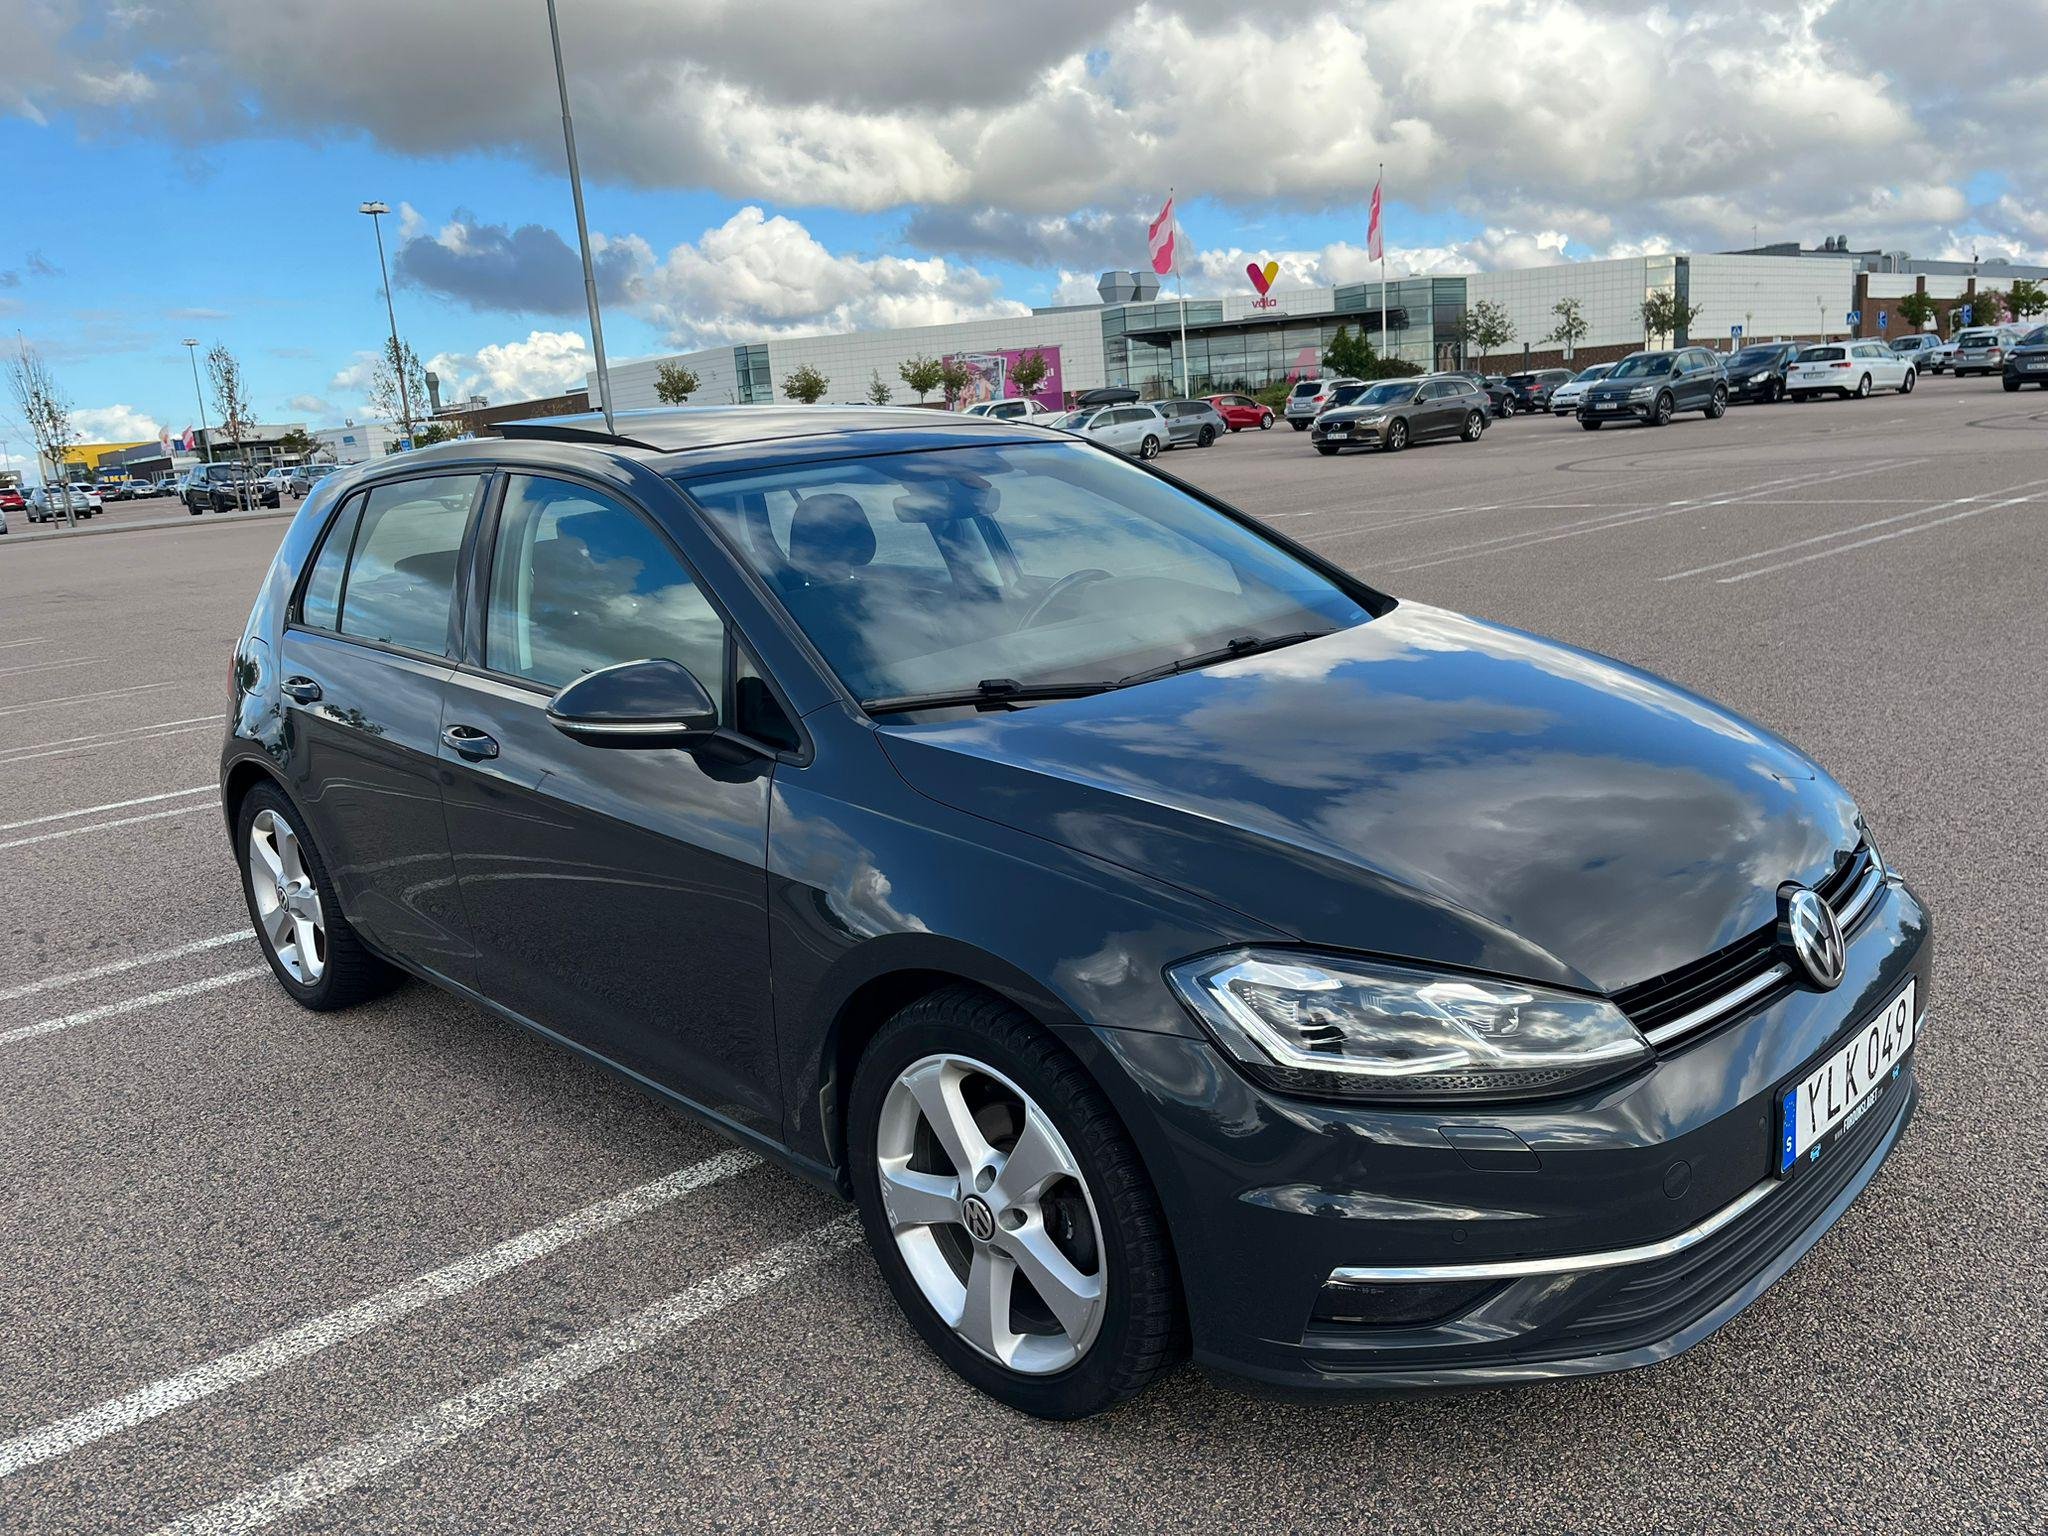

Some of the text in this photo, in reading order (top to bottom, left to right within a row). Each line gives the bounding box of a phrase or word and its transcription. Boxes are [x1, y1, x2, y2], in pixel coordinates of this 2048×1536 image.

[1808, 998, 1907, 1134] YLK 049
[1786, 1136, 1793, 1153] S
